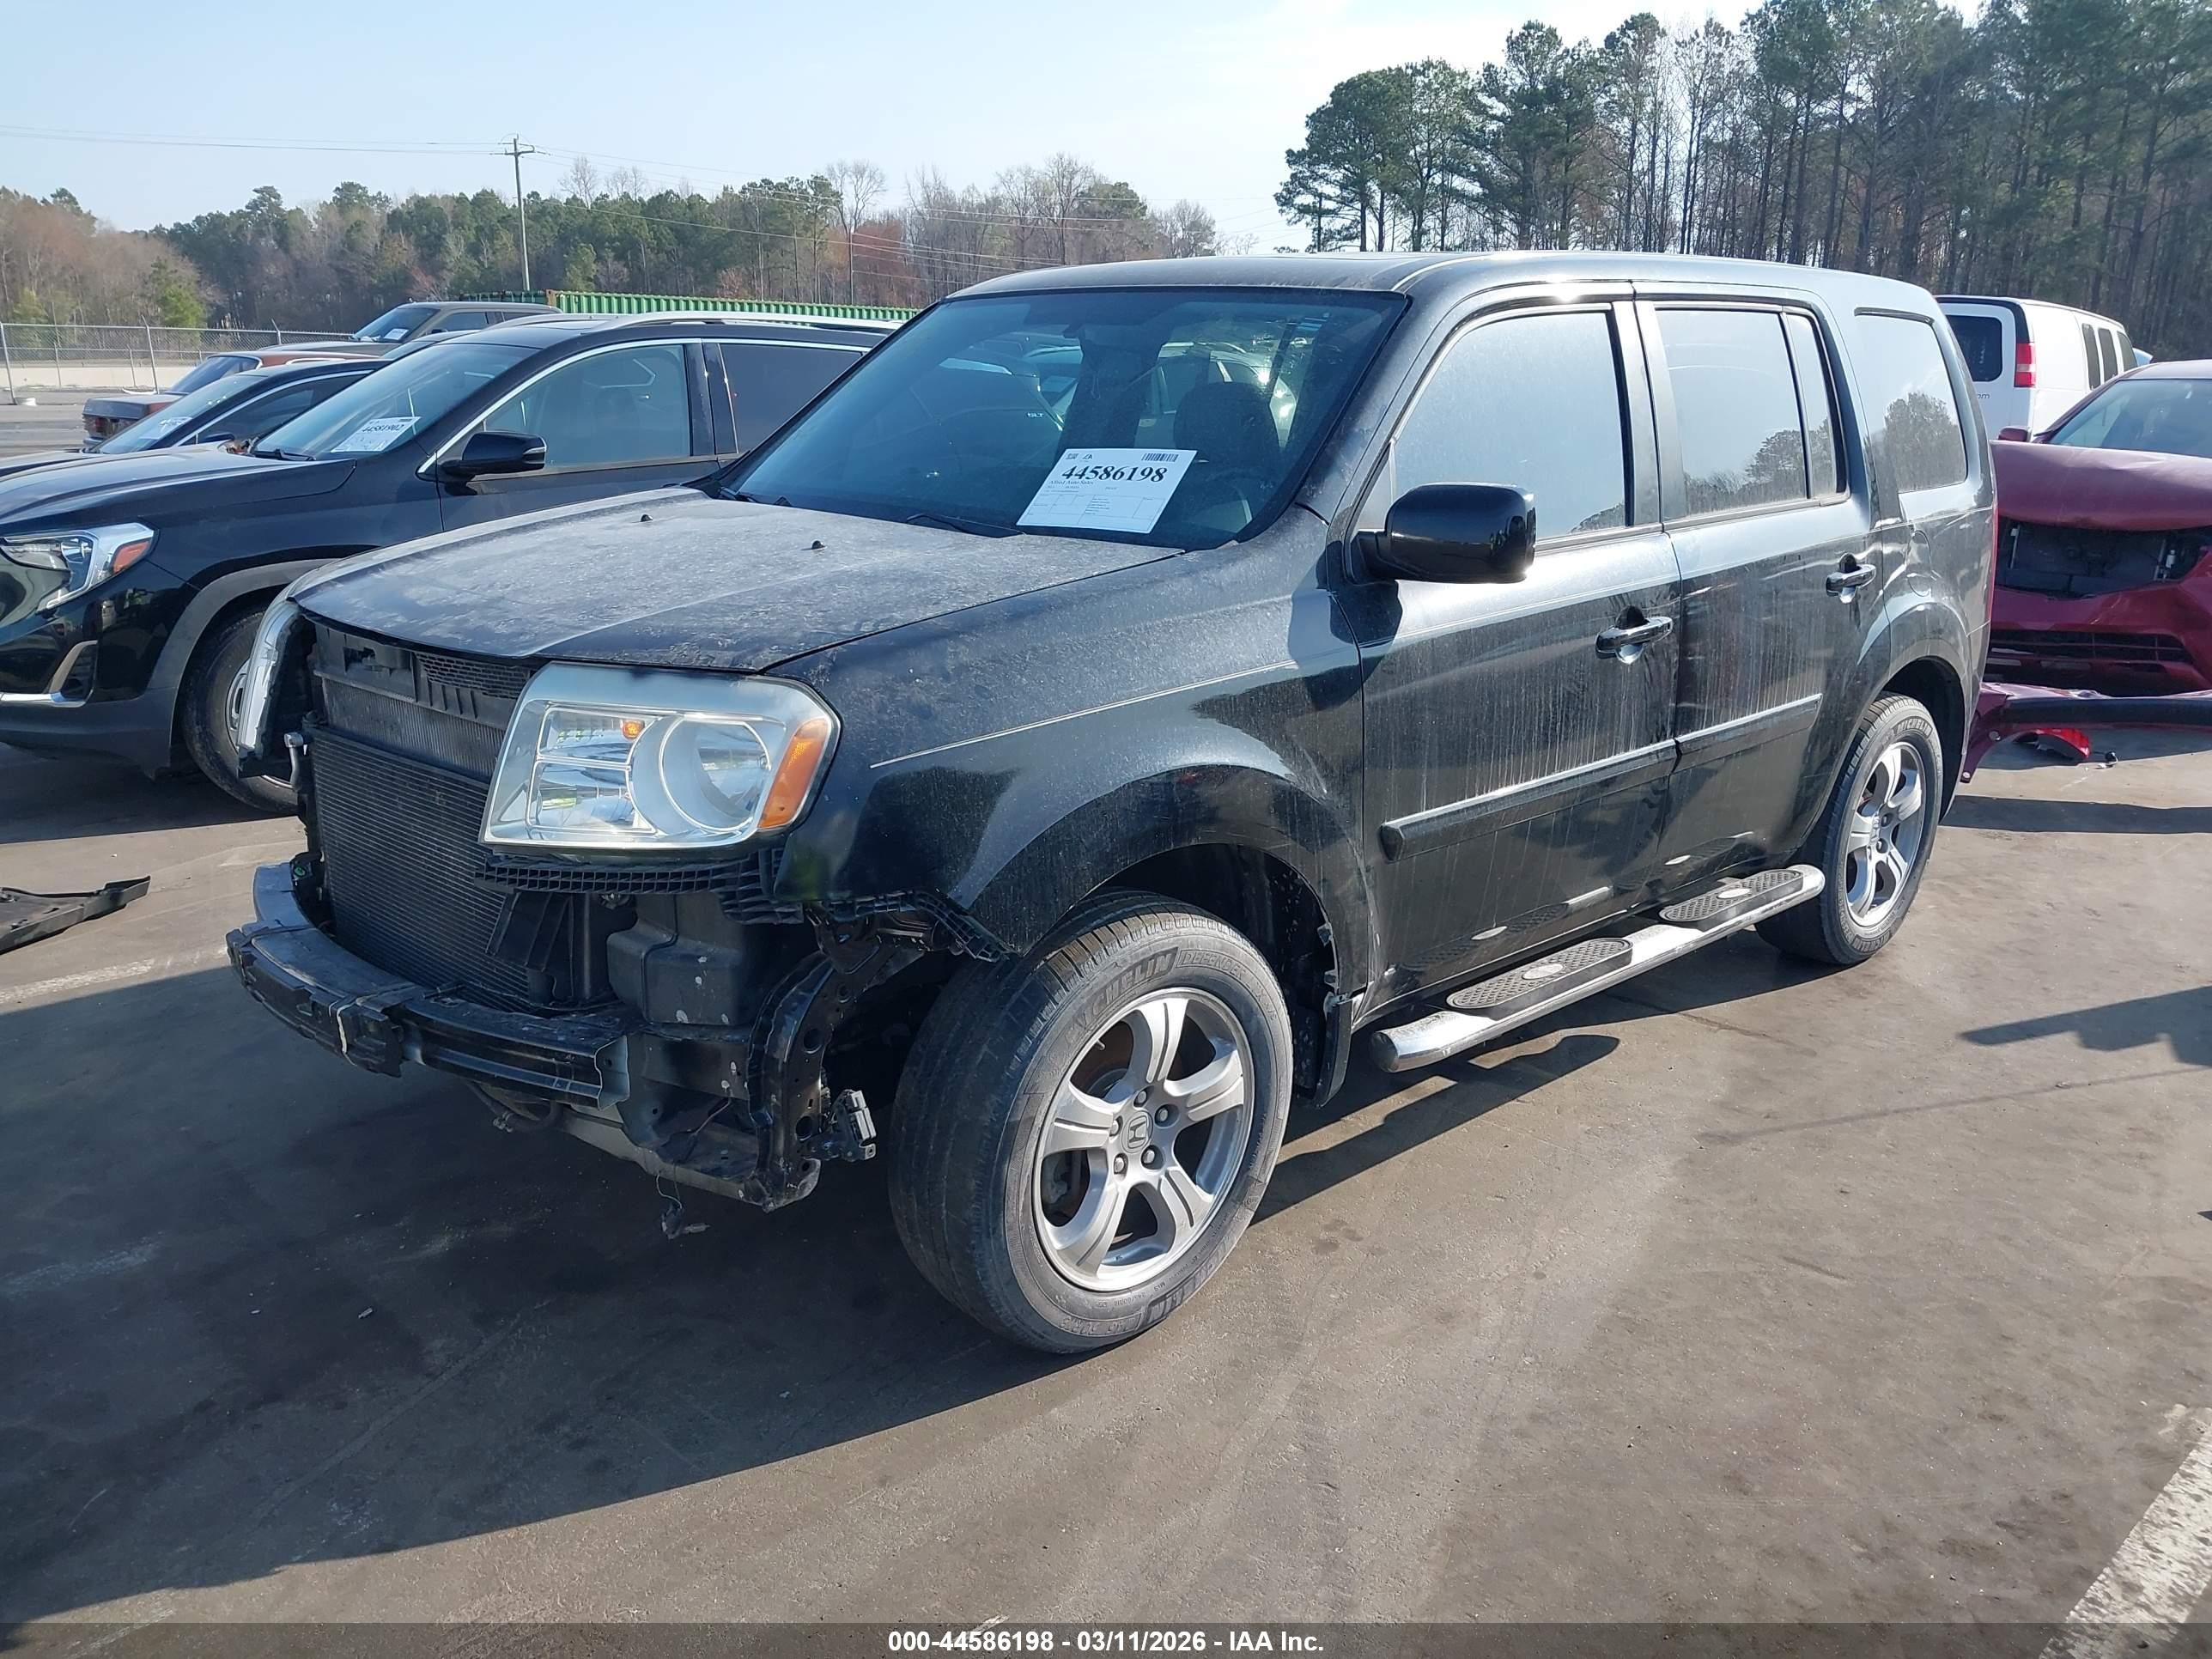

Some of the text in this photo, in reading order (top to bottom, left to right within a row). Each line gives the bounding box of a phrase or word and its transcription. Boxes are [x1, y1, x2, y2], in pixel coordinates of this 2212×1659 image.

[1061, 465, 1168, 483] 44586198
[1896, 718, 1933, 736] MICHELIN
[1063, 952, 1173, 1047] MICHELIN
